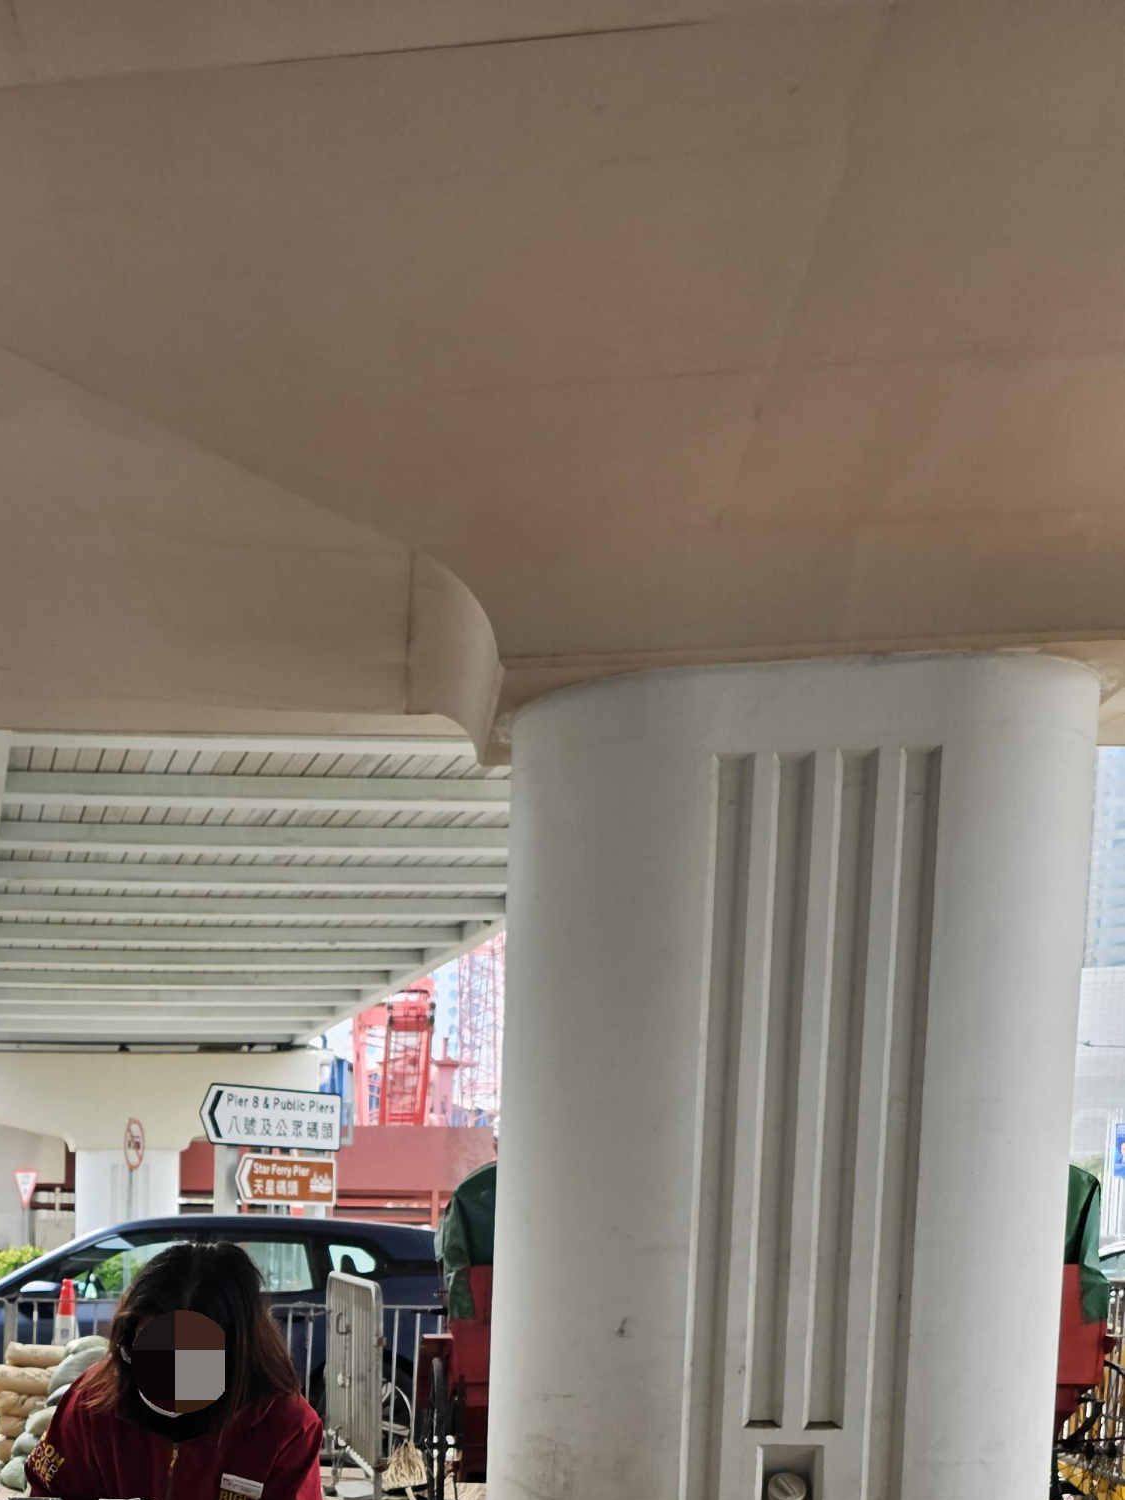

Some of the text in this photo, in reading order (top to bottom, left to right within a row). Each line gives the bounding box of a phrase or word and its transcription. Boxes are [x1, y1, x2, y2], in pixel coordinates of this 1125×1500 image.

[227, 1093, 334, 1114] Pier 8 & Public Piers
[253, 1162, 310, 1179] Star Ferry Pier
